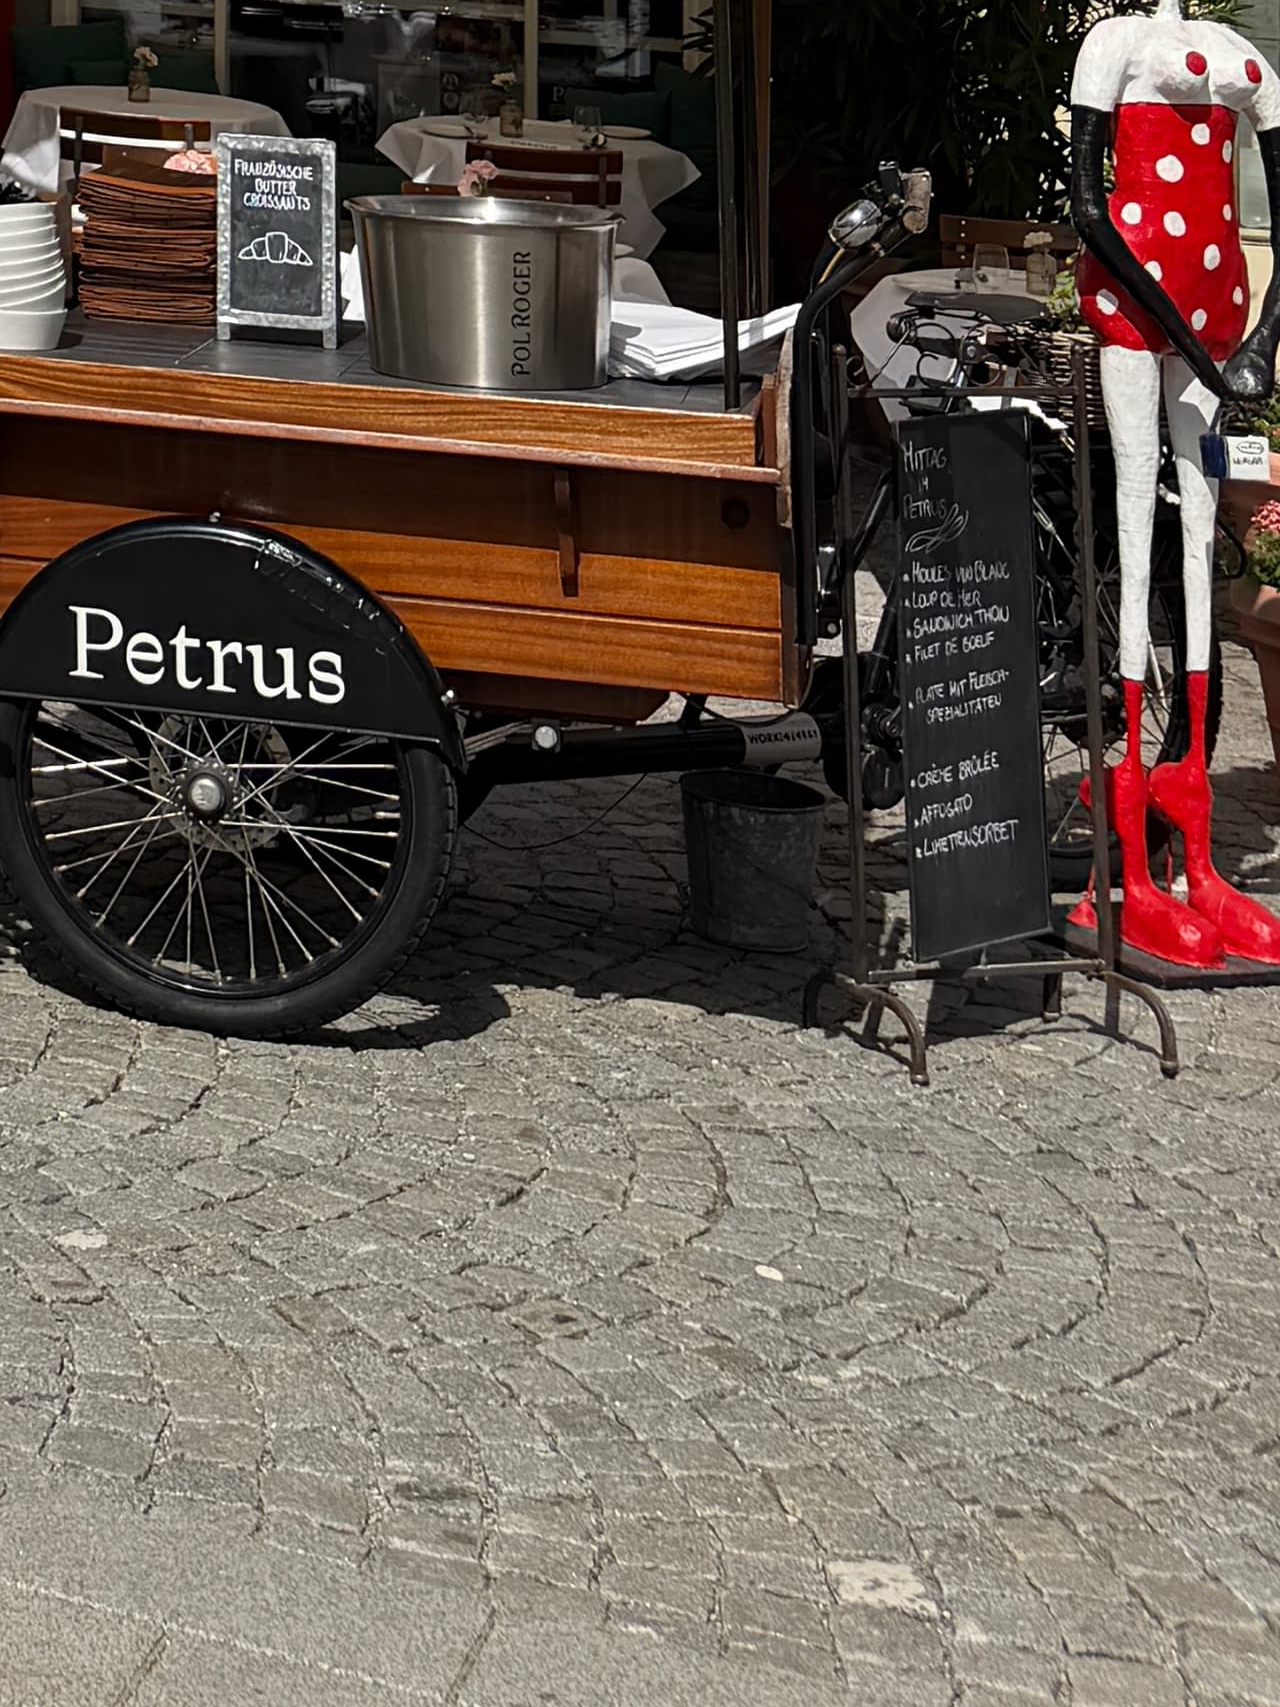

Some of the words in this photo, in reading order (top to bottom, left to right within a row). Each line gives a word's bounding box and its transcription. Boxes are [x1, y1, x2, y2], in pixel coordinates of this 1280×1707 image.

[254, 178, 297, 196] BUTTER
[243, 192, 311, 211] CROISSANTS
[511, 251, 531, 329] ROGER
[511, 332, 531, 377] POL
[68, 605, 346, 704] Petrus
[914, 642, 941, 663] FILET
[949, 679, 967, 698] MIT
[920, 793, 973, 826] AFFOGATO
